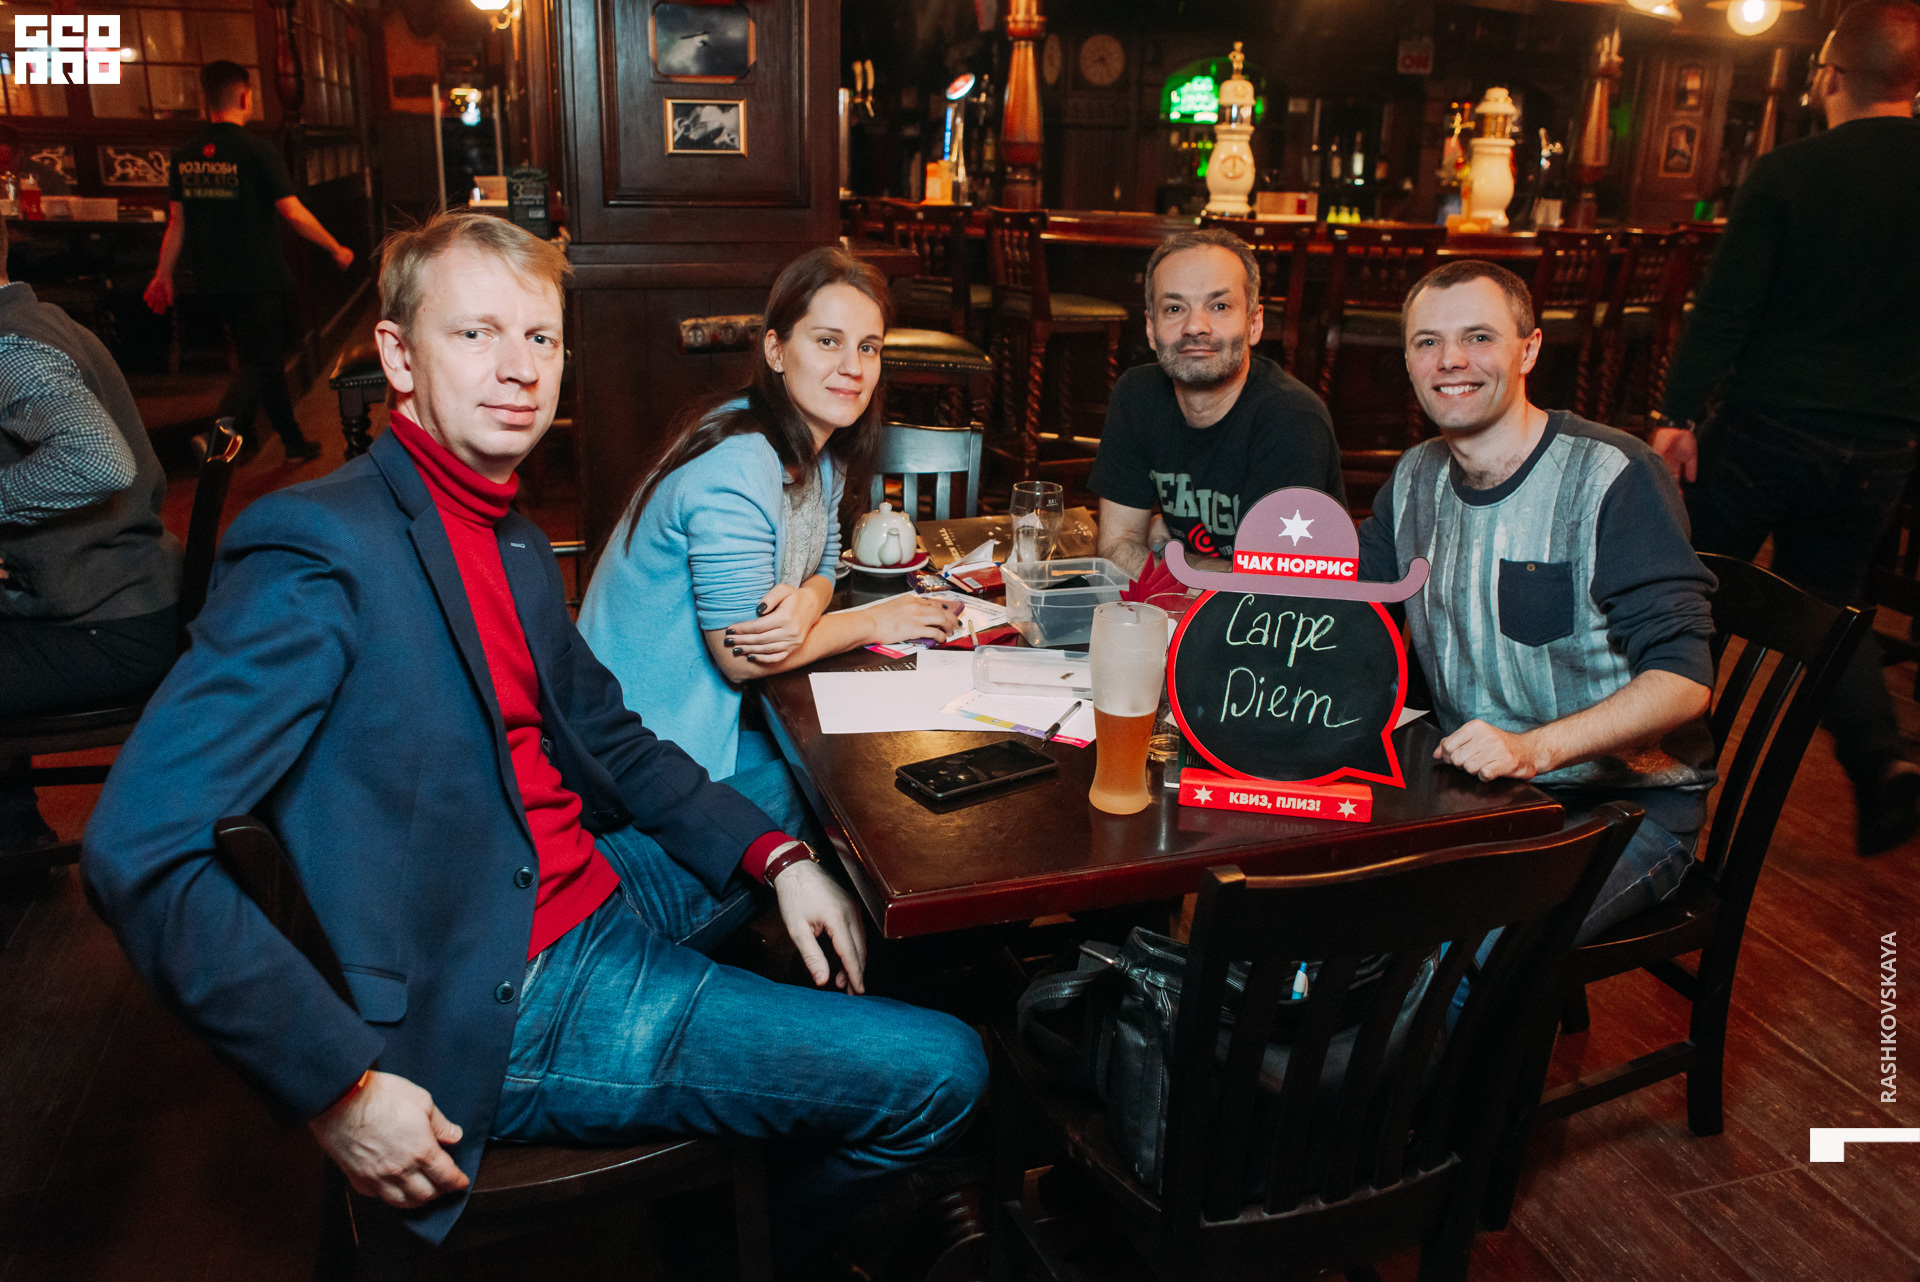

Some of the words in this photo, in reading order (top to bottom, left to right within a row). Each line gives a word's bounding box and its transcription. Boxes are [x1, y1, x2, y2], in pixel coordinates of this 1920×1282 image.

[1236, 554, 1274, 571] ЧАК
[1276, 557, 1355, 577] НОРРИС
[1225, 593, 1338, 668] Carpe
[1219, 666, 1361, 730] Diem
[1228, 791, 1273, 810] КВИЗ,
[1275, 796, 1322, 812] ПЛИЗ!
